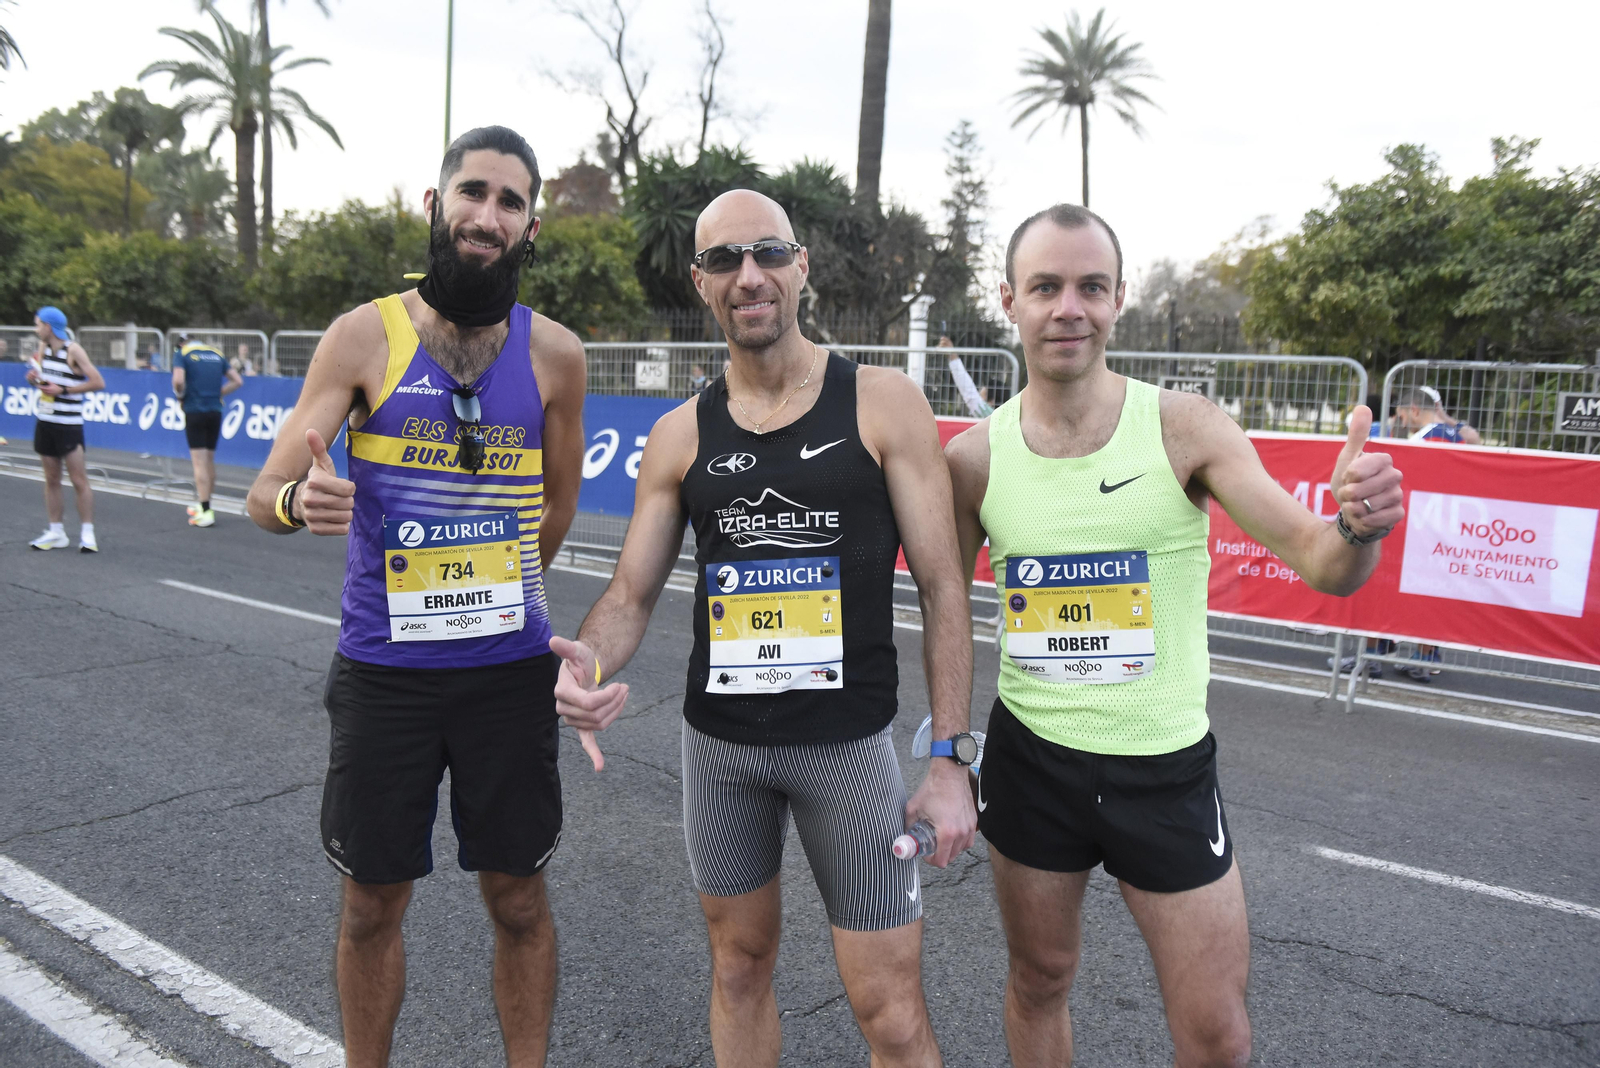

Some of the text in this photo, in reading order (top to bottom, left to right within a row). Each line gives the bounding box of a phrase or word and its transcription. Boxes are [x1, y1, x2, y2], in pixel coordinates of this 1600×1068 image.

[396, 386, 444, 396] MERCURY
[82, 391, 131, 425] asics
[402, 417, 447, 441] ELS
[714, 507, 746, 518] TEAM
[718, 511, 840, 534] IZRA-ELITE
[430, 520, 504, 541] ZURICH
[1432, 542, 1559, 571] AYUNTAMIENTO
[439, 561, 475, 581] 734
[743, 567, 822, 587] ZURICH
[1048, 560, 1131, 580] ZURICH
[1237, 561, 1305, 584] de Dep
[1449, 562, 1469, 576] DE
[424, 590, 493, 609] ERRANTE
[751, 609, 783, 630] 621
[1058, 603, 1091, 623] 401
[408, 622, 427, 630] asics
[757, 644, 781, 660] AVI
[1047, 636, 1110, 652] ROBERT
[1028, 664, 1046, 673] asics
